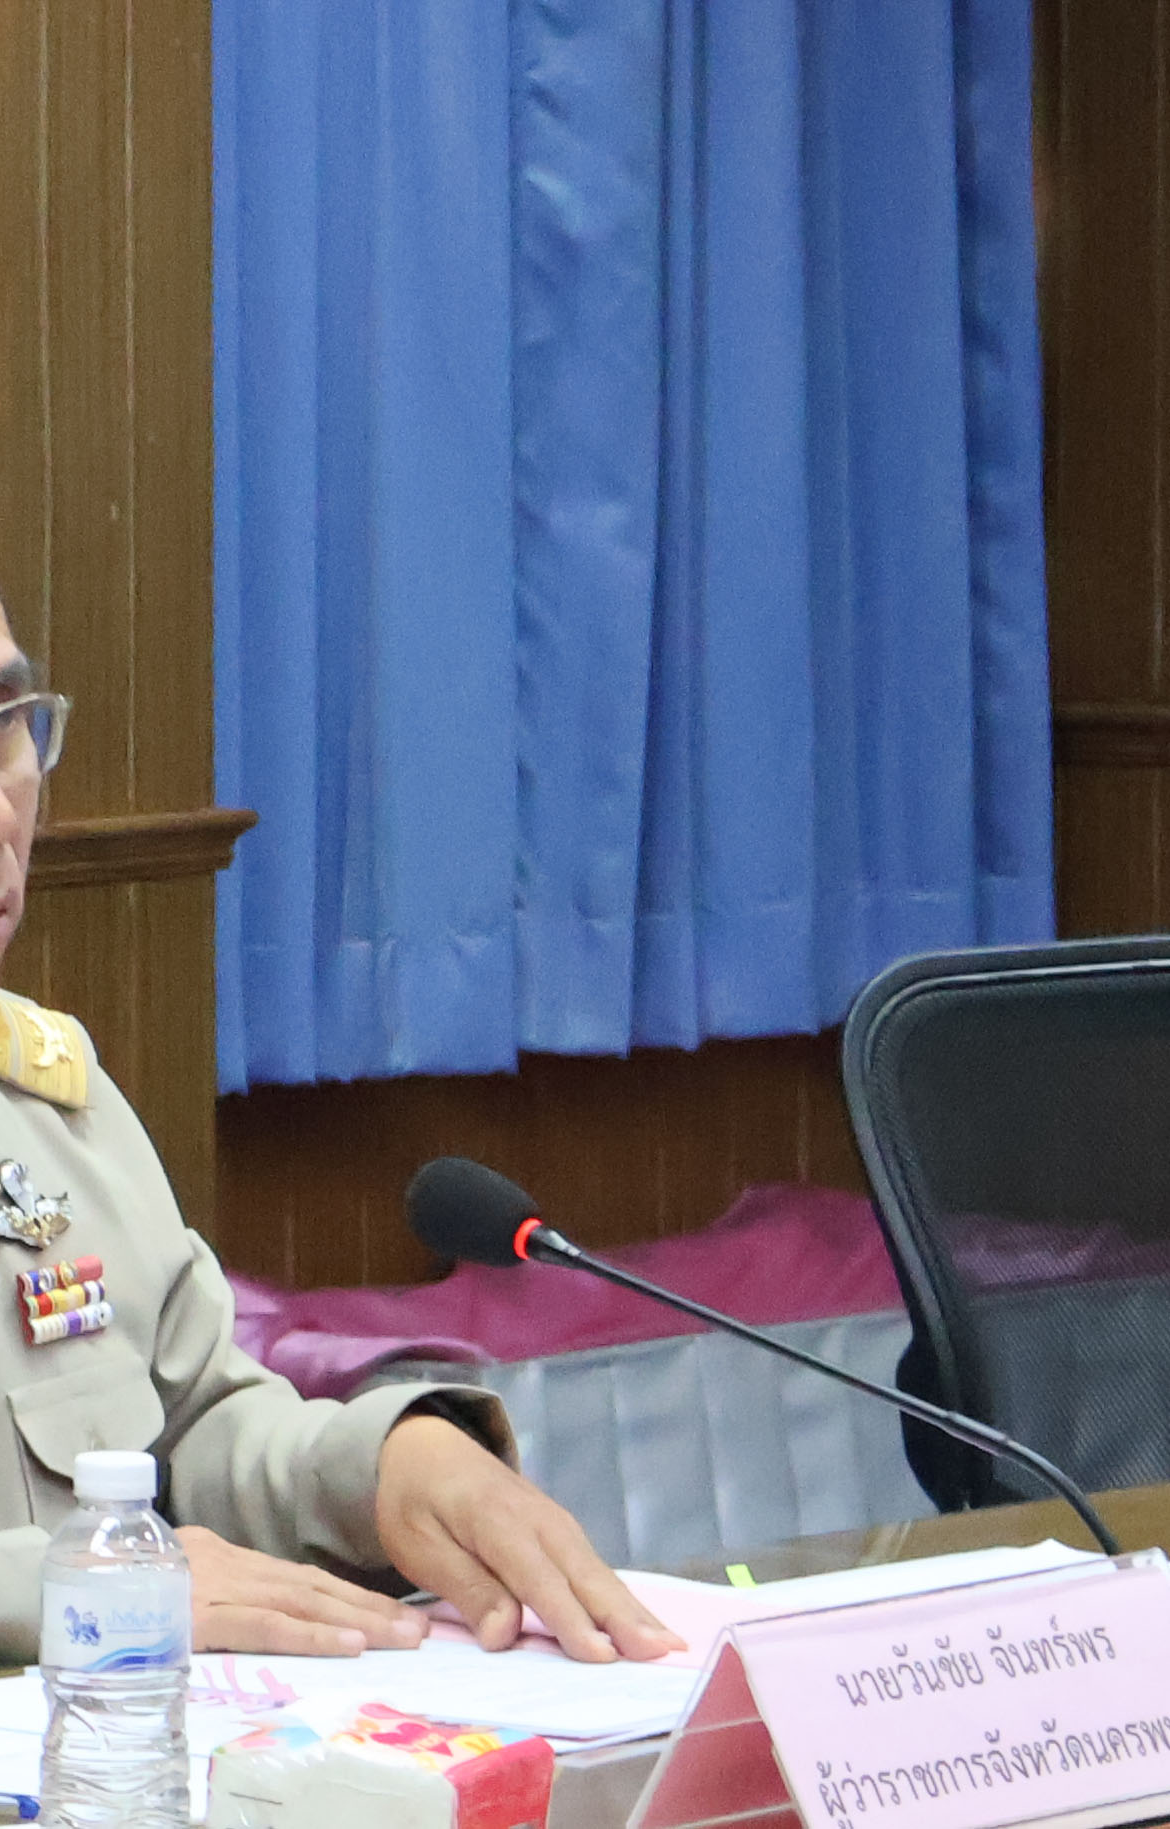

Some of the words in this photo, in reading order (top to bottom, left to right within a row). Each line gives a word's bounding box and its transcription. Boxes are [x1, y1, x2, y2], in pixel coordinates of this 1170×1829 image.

[836, 1635, 984, 1707] นายวันชัย
[986, 1614, 1116, 1678] จันทร์พร
[816, 1716, 1170, 1829] ผู้ว่าราชการจังหวัดนครพ
